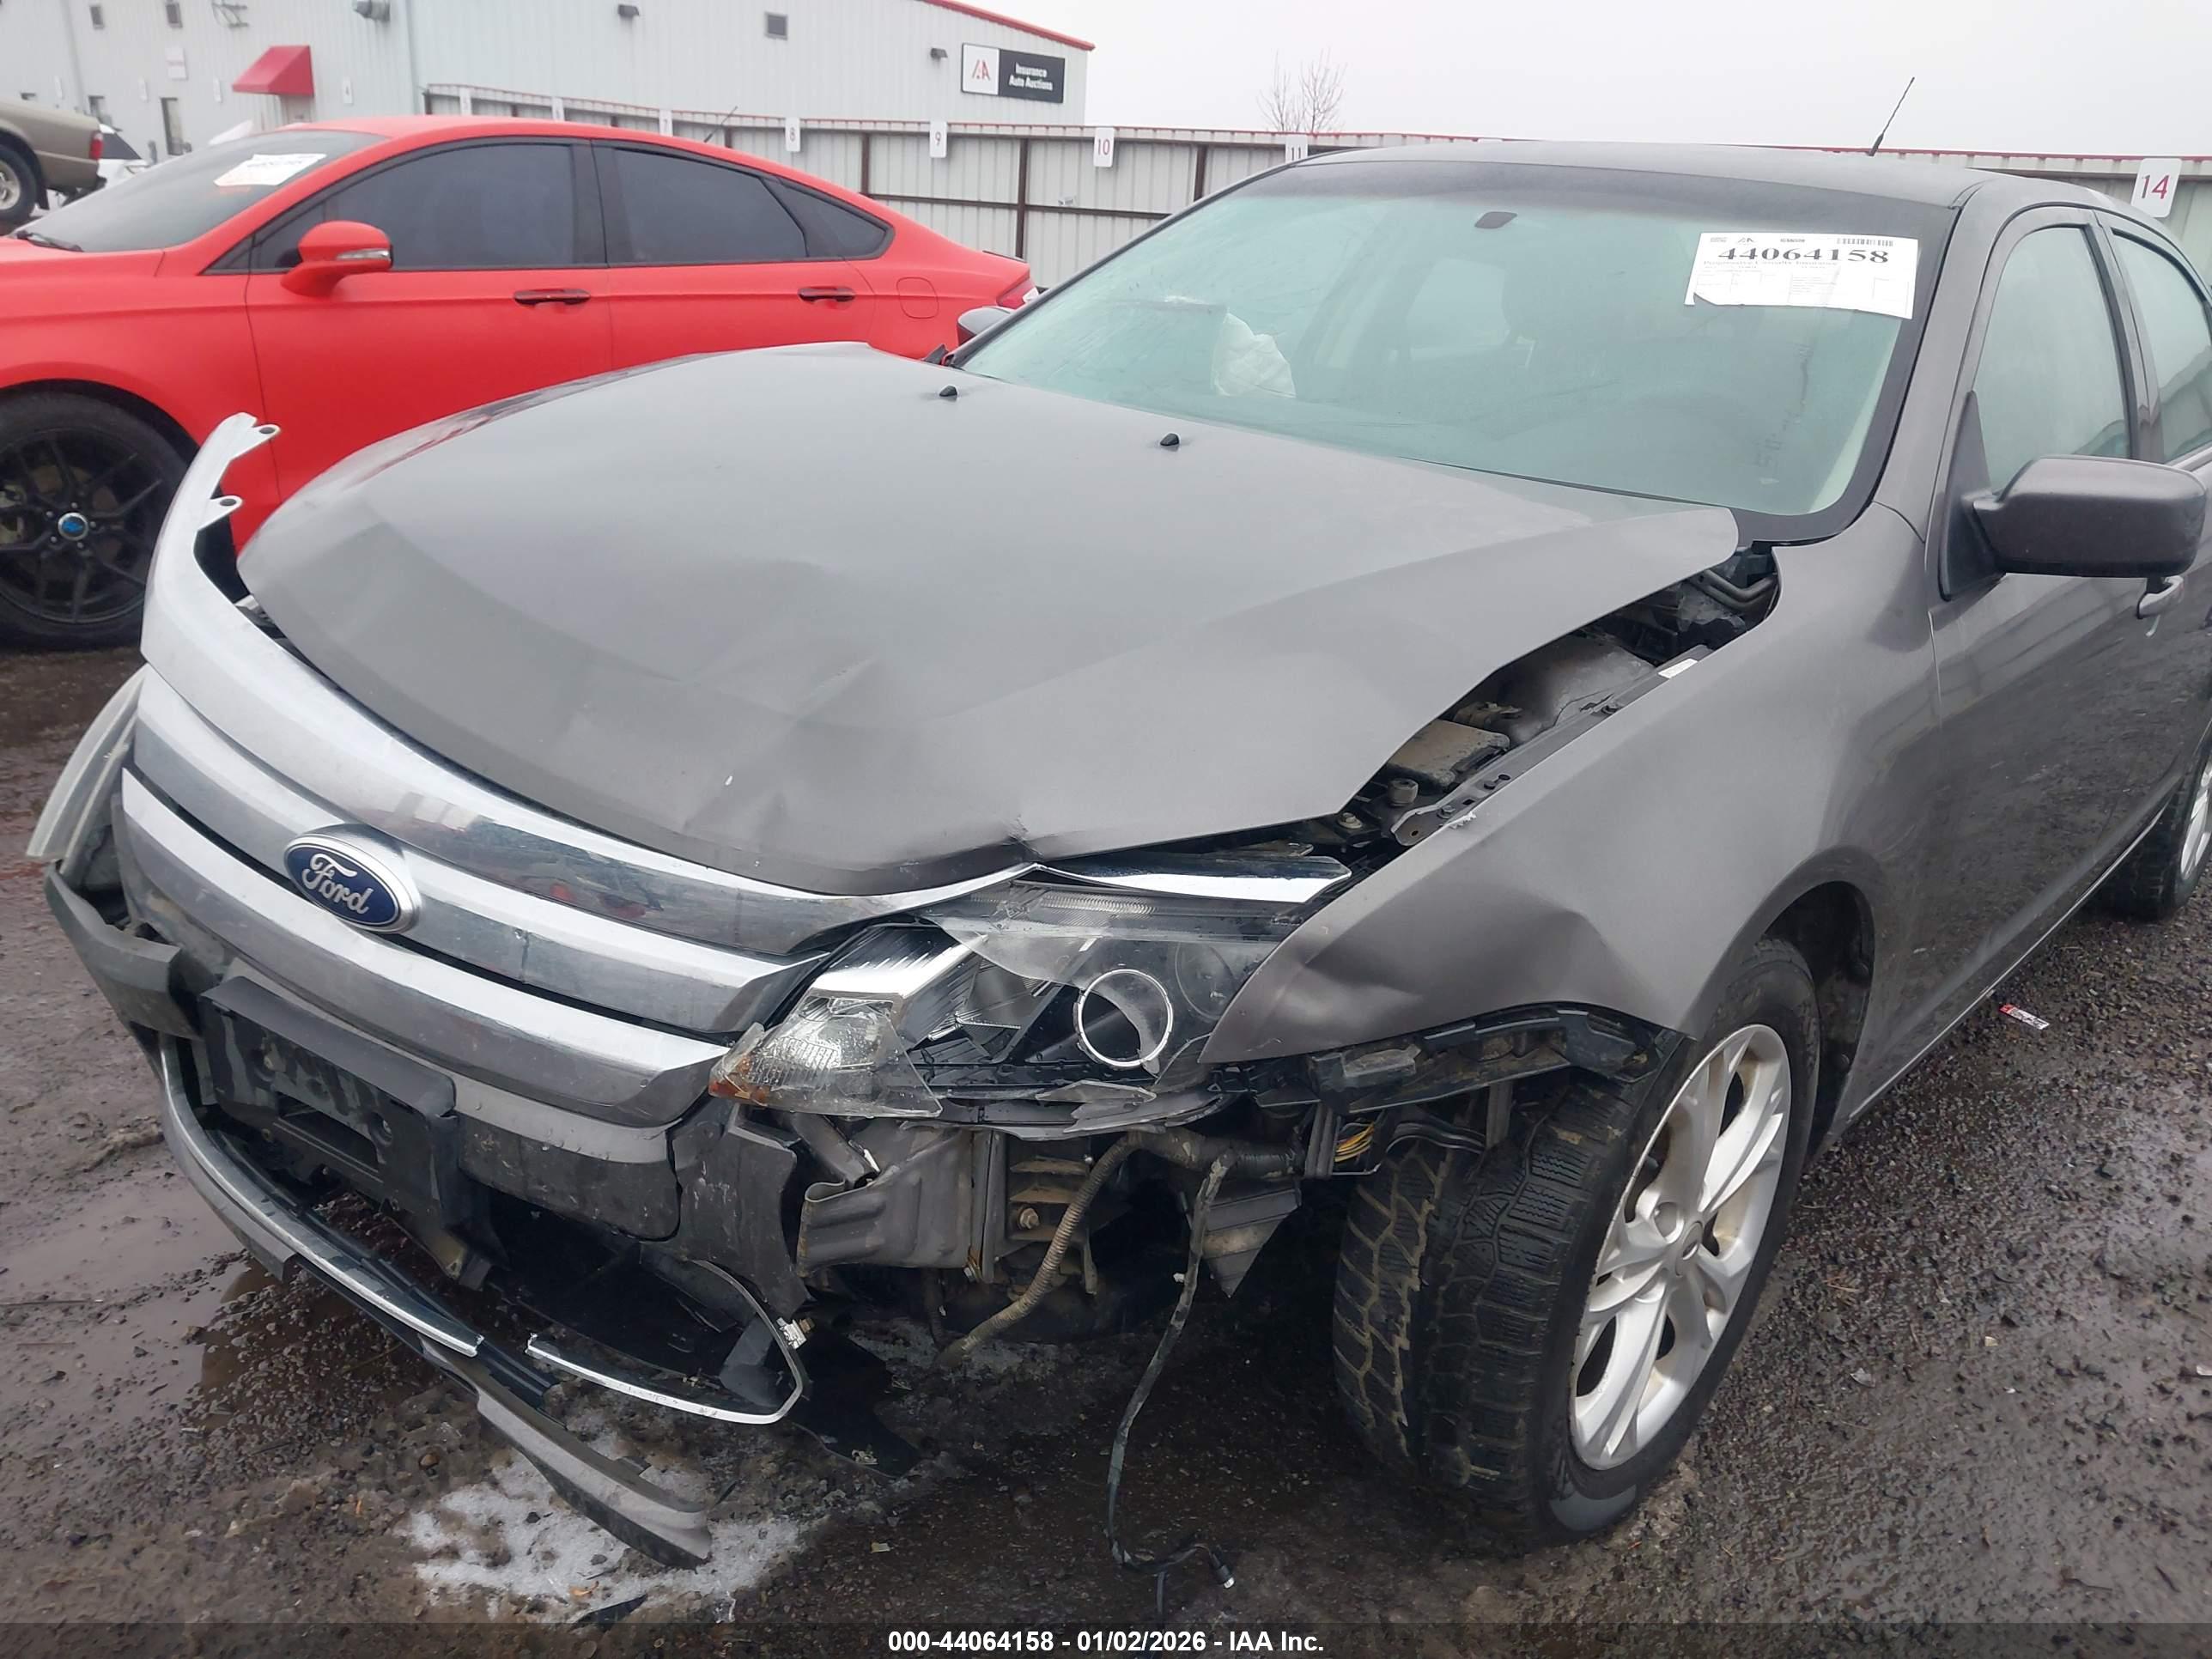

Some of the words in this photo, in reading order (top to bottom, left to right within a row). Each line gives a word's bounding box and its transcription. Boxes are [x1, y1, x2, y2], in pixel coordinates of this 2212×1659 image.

[1015, 61, 1048, 78] Insurance
[1008, 74, 1025, 88] Auto
[1024, 76, 1054, 92] Auctions
[935, 131, 942, 146] 9
[1097, 138, 1110, 155] 10
[2141, 174, 2170, 199] 14
[1717, 247, 1889, 264] 44064158
[301, 853, 374, 915] Ford
